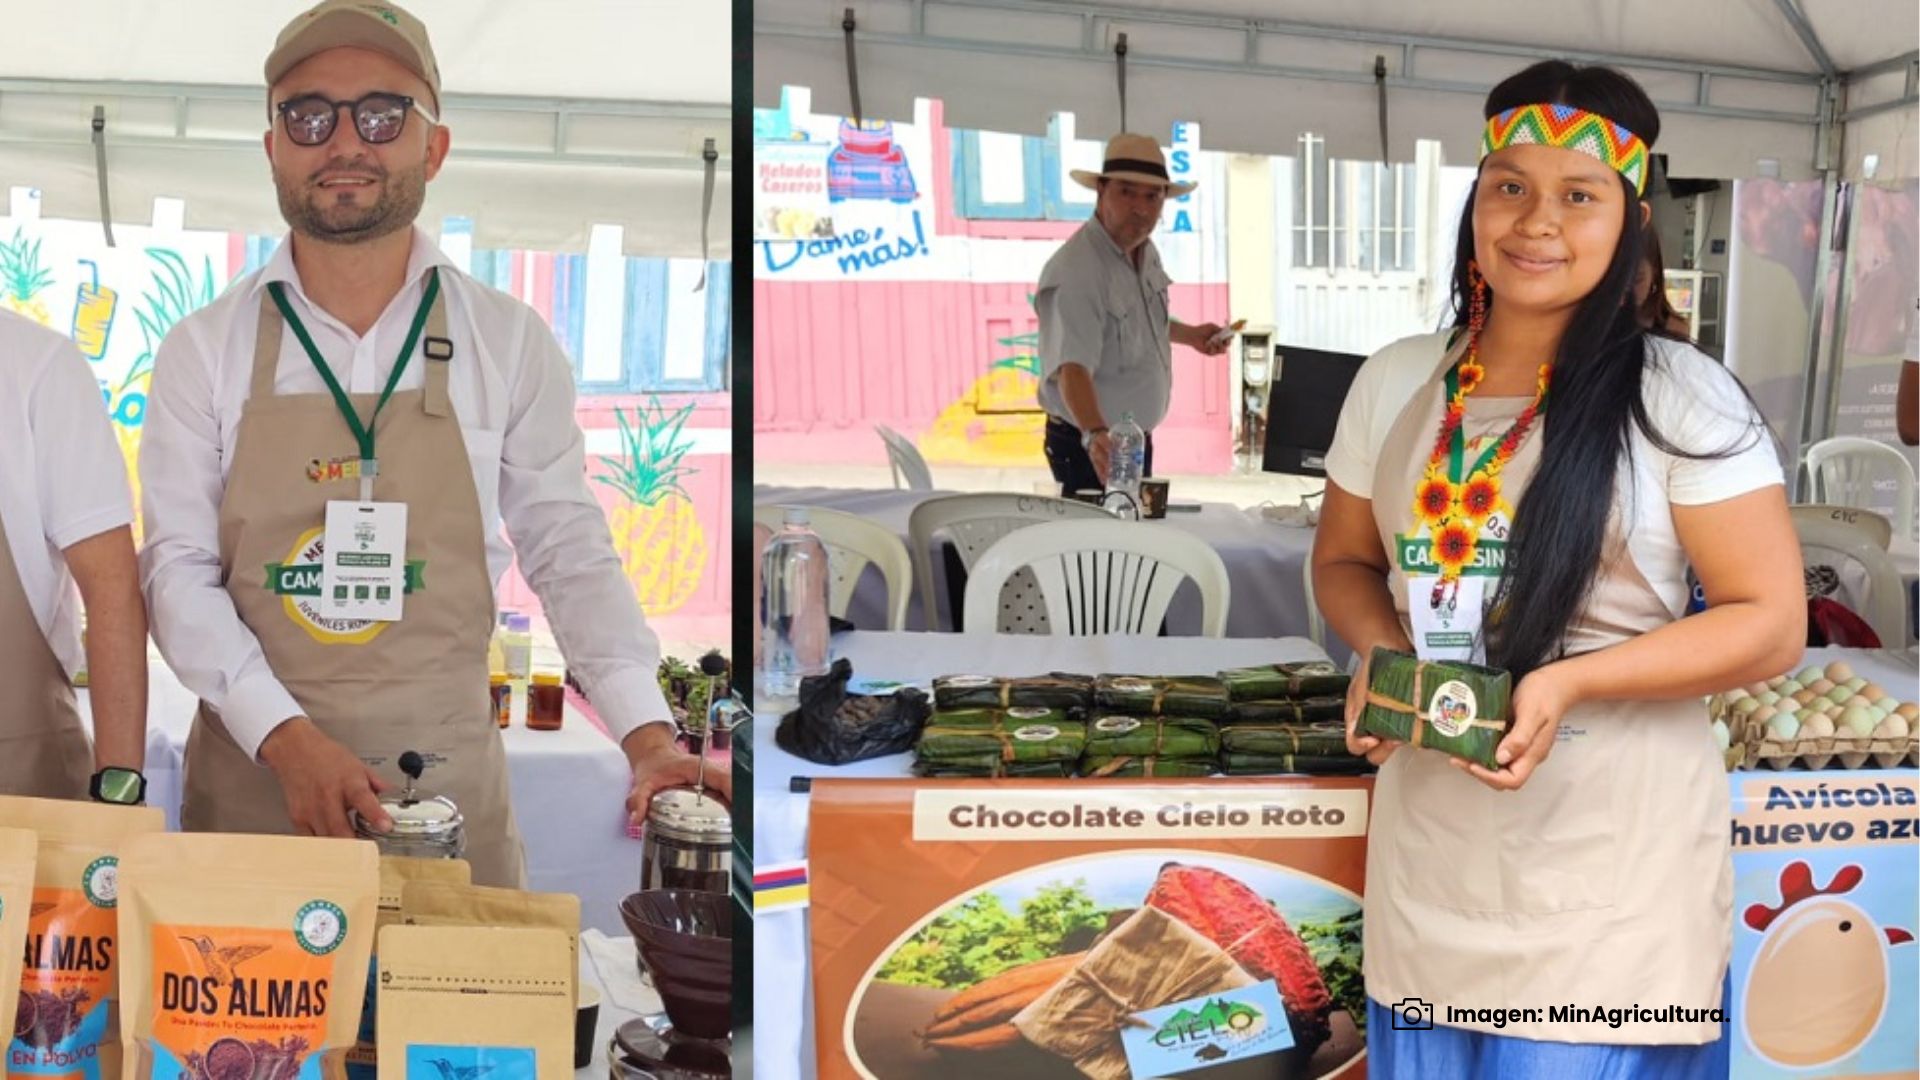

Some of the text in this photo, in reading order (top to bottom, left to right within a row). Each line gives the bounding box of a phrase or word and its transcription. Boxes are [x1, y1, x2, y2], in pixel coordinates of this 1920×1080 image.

[760, 163, 821, 178] Helados
[762, 178, 822, 193] Caseros
[1764, 783, 1917, 811] Avícola
[948, 804, 1346, 828] Chocolate Cielo Roto
[1731, 819, 1854, 846] huevo
[162, 972, 328, 1018] DOS ALMAS
[1155, 1010, 1254, 1048] CIELO
[12, 1050, 37, 1066] EN
